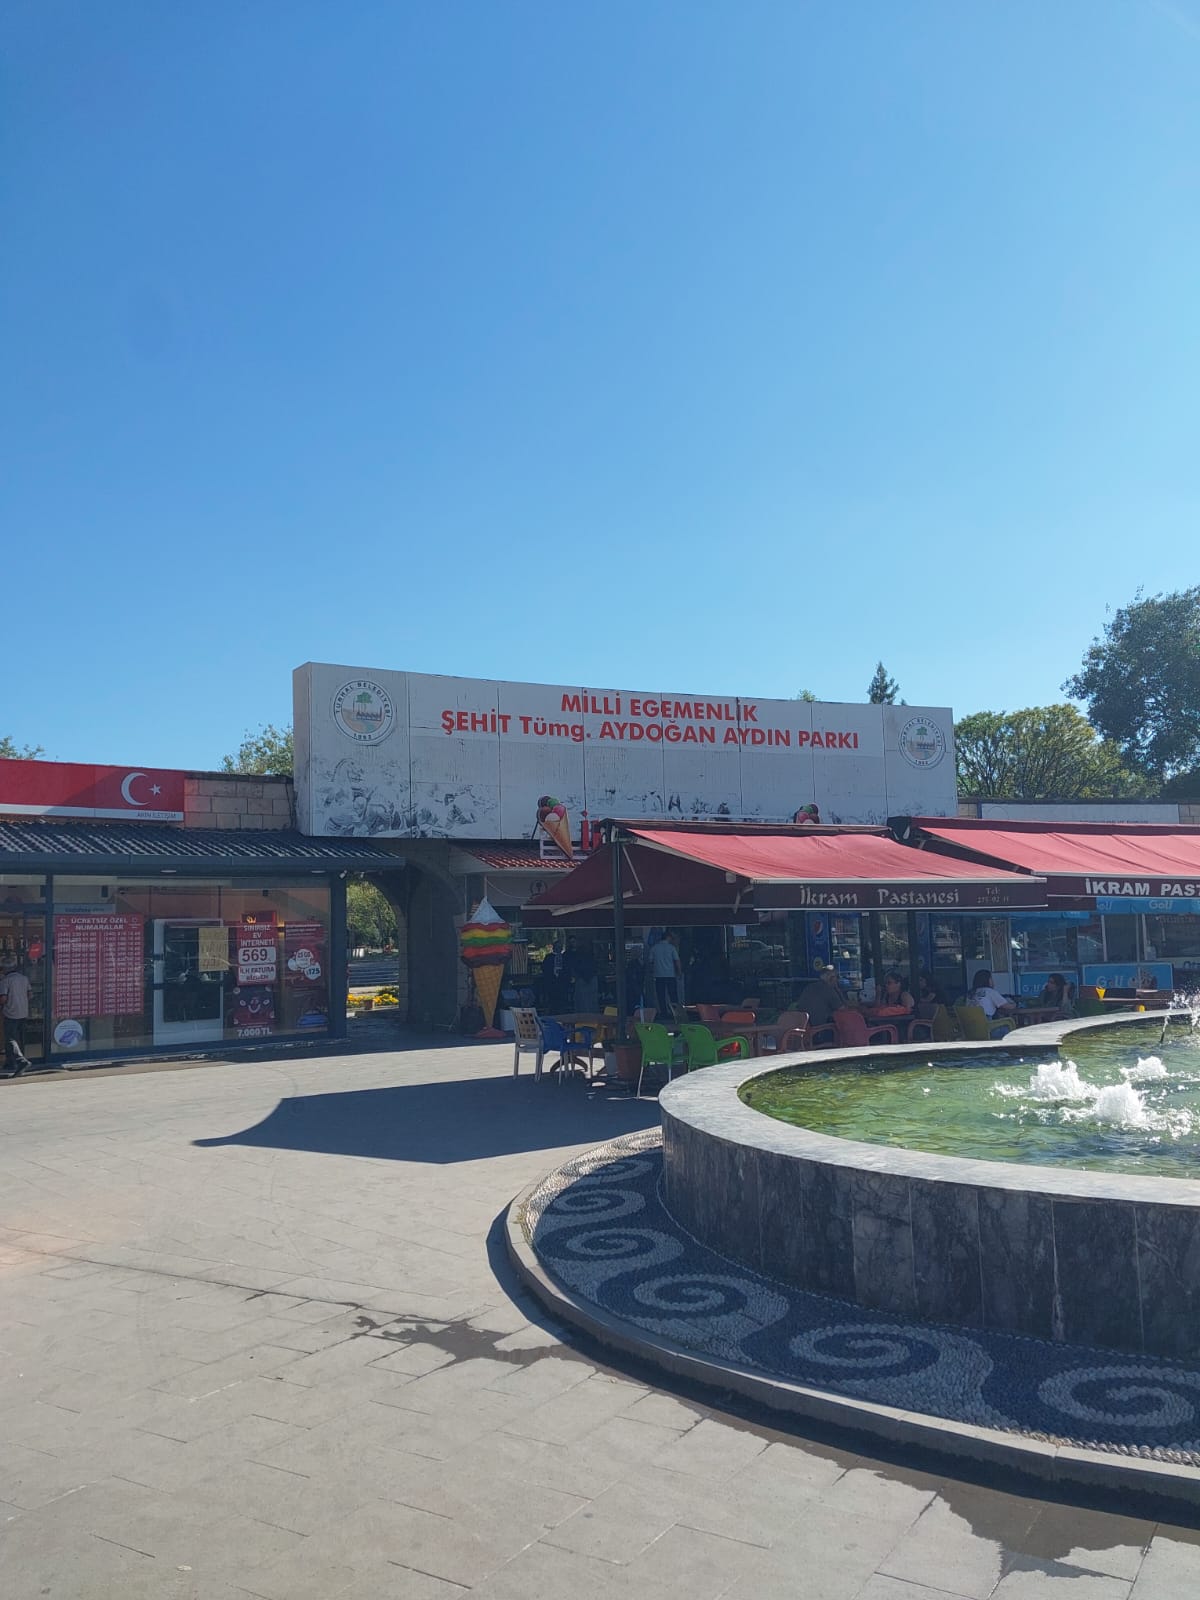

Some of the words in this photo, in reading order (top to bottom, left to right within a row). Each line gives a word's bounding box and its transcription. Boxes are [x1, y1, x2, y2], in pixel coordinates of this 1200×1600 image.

[561, 690, 621, 715] MİLLİ
[630, 699, 758, 722] EGEMENLİK
[441, 708, 511, 736] ŞEHİT
[519, 716, 591, 742] Tümg.
[599, 720, 716, 743] AYDOĞAN
[723, 727, 790, 747] AYDIN
[798, 730, 859, 749] PARKI
[1085, 878, 1150, 896] İKRAM
[800, 885, 858, 905] İkram
[878, 888, 960, 905] Pastanesi
[71, 916, 108, 924] ÜCRETSİZ
[109, 916, 128, 924] ÖZEL
[240, 938, 274, 947] İNTERNETİ
[242, 949, 268, 962] 569
[262, 1027, 272, 1035] TL
